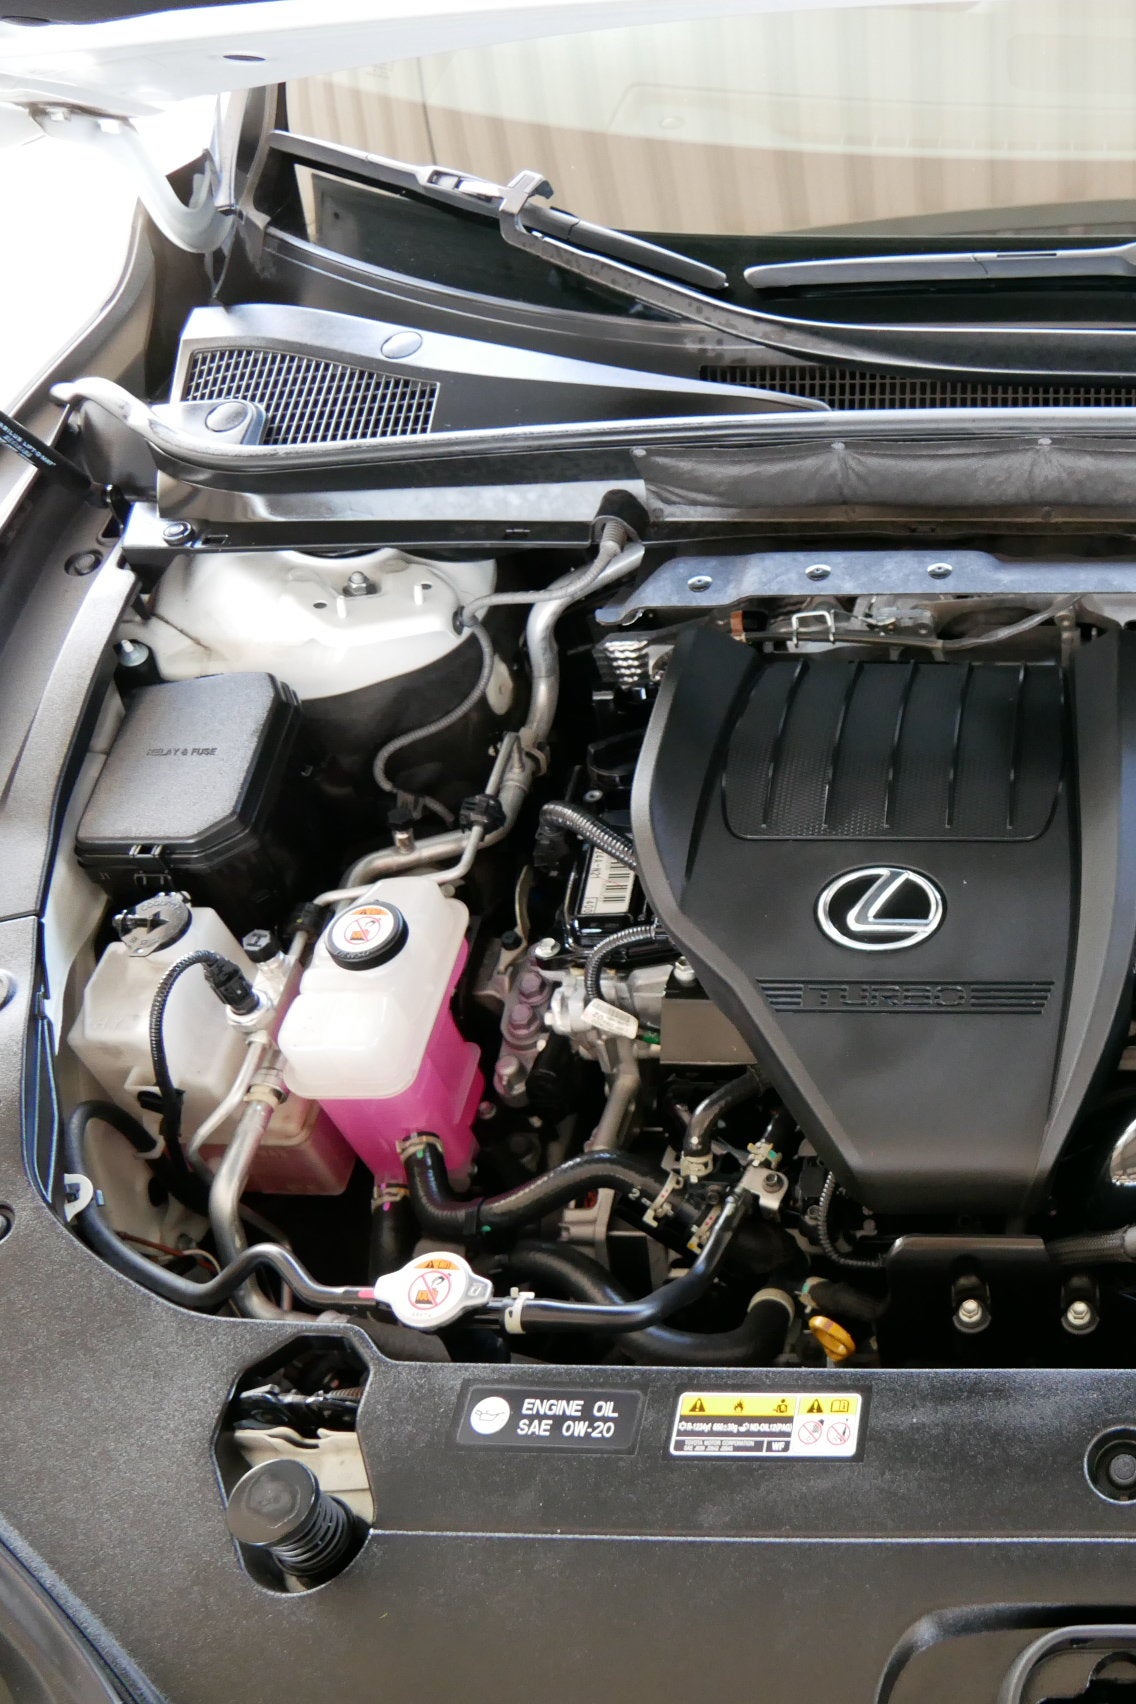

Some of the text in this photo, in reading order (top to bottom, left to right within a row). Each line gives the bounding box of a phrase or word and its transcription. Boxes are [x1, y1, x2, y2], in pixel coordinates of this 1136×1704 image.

[190, 747, 218, 756] FUSE
[808, 985, 966, 1007] TURBO
[521, 1399, 619, 1418] ENGINE OIL
[516, 1419, 615, 1438] SAE 0W-20
[771, 1441, 785, 1451] WF
